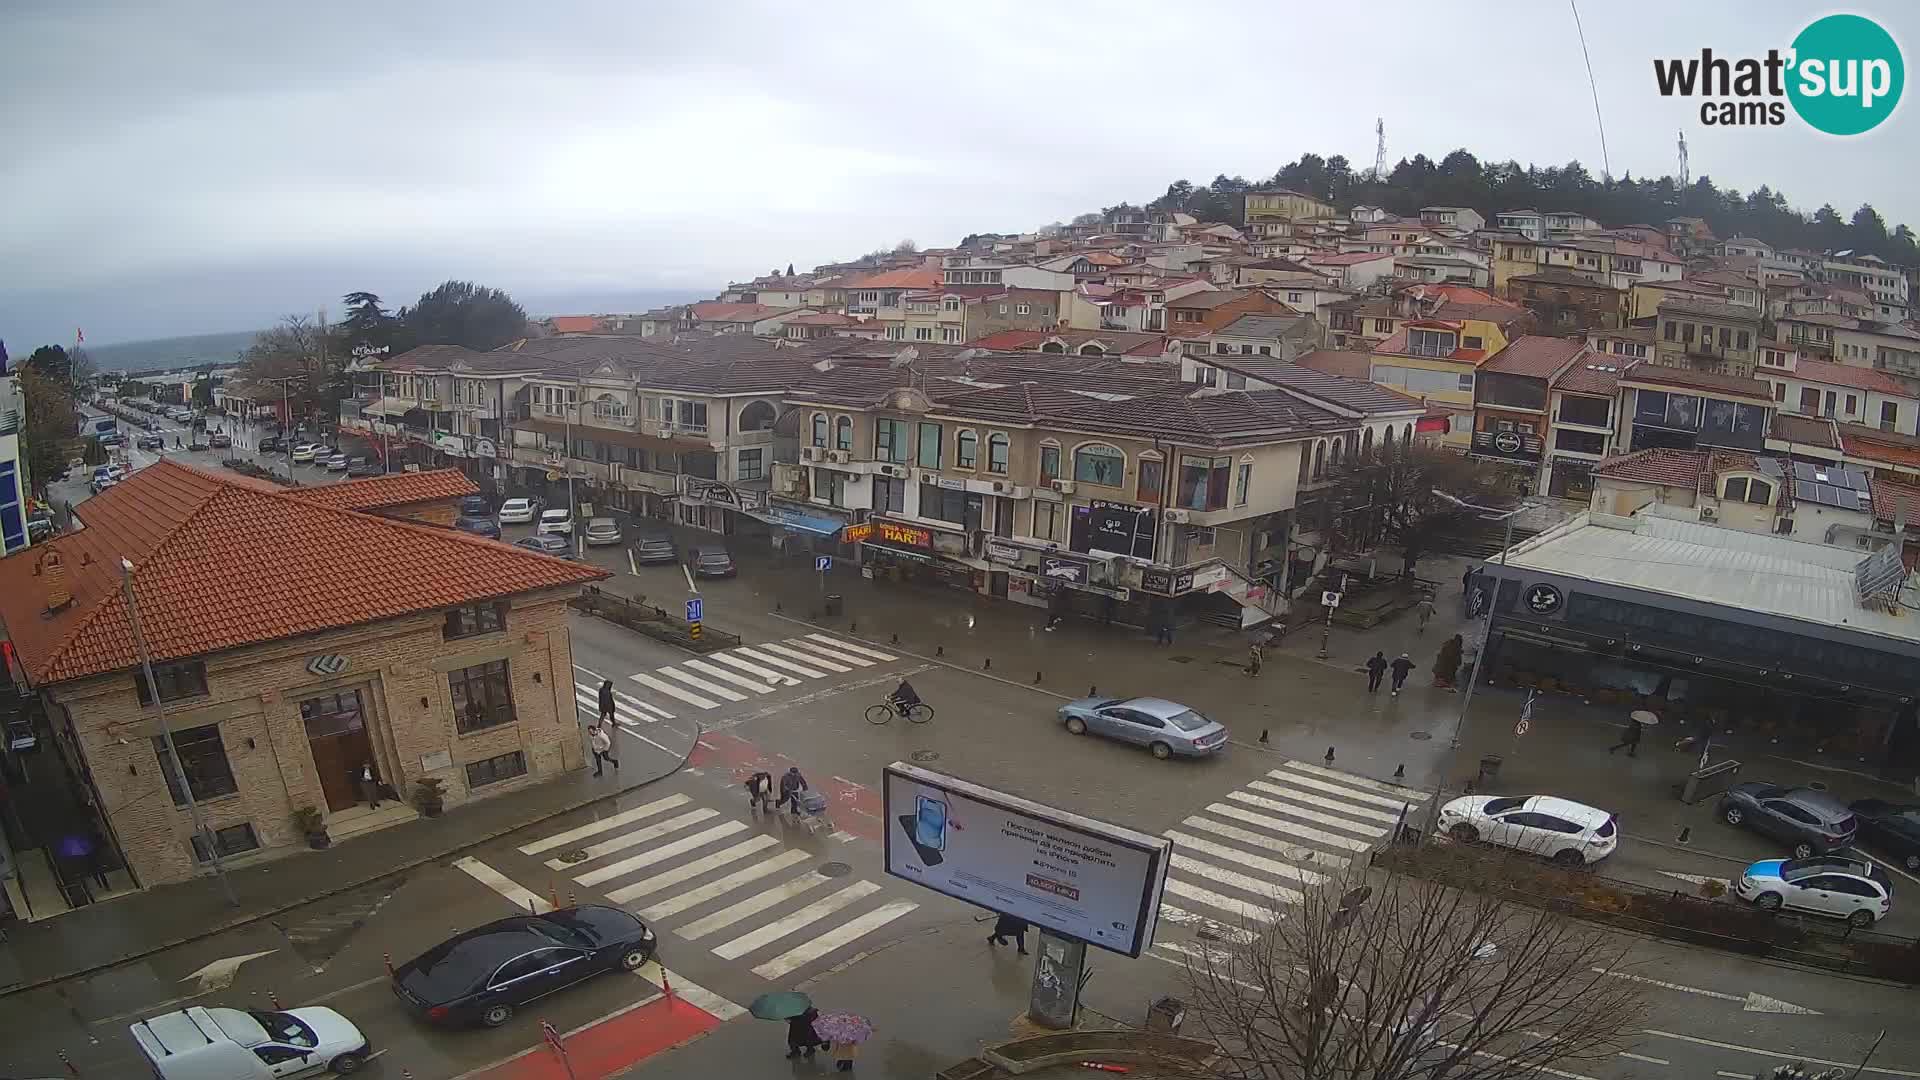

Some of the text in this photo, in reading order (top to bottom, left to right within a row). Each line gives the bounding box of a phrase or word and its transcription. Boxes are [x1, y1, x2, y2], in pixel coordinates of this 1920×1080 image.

[884, 529, 917, 545] HARI
[1006, 821, 1044, 838] Постојат
[1082, 845, 1112, 858] добри
[1039, 840, 1051, 850] да
[1049, 851, 1079, 865] iPhone
